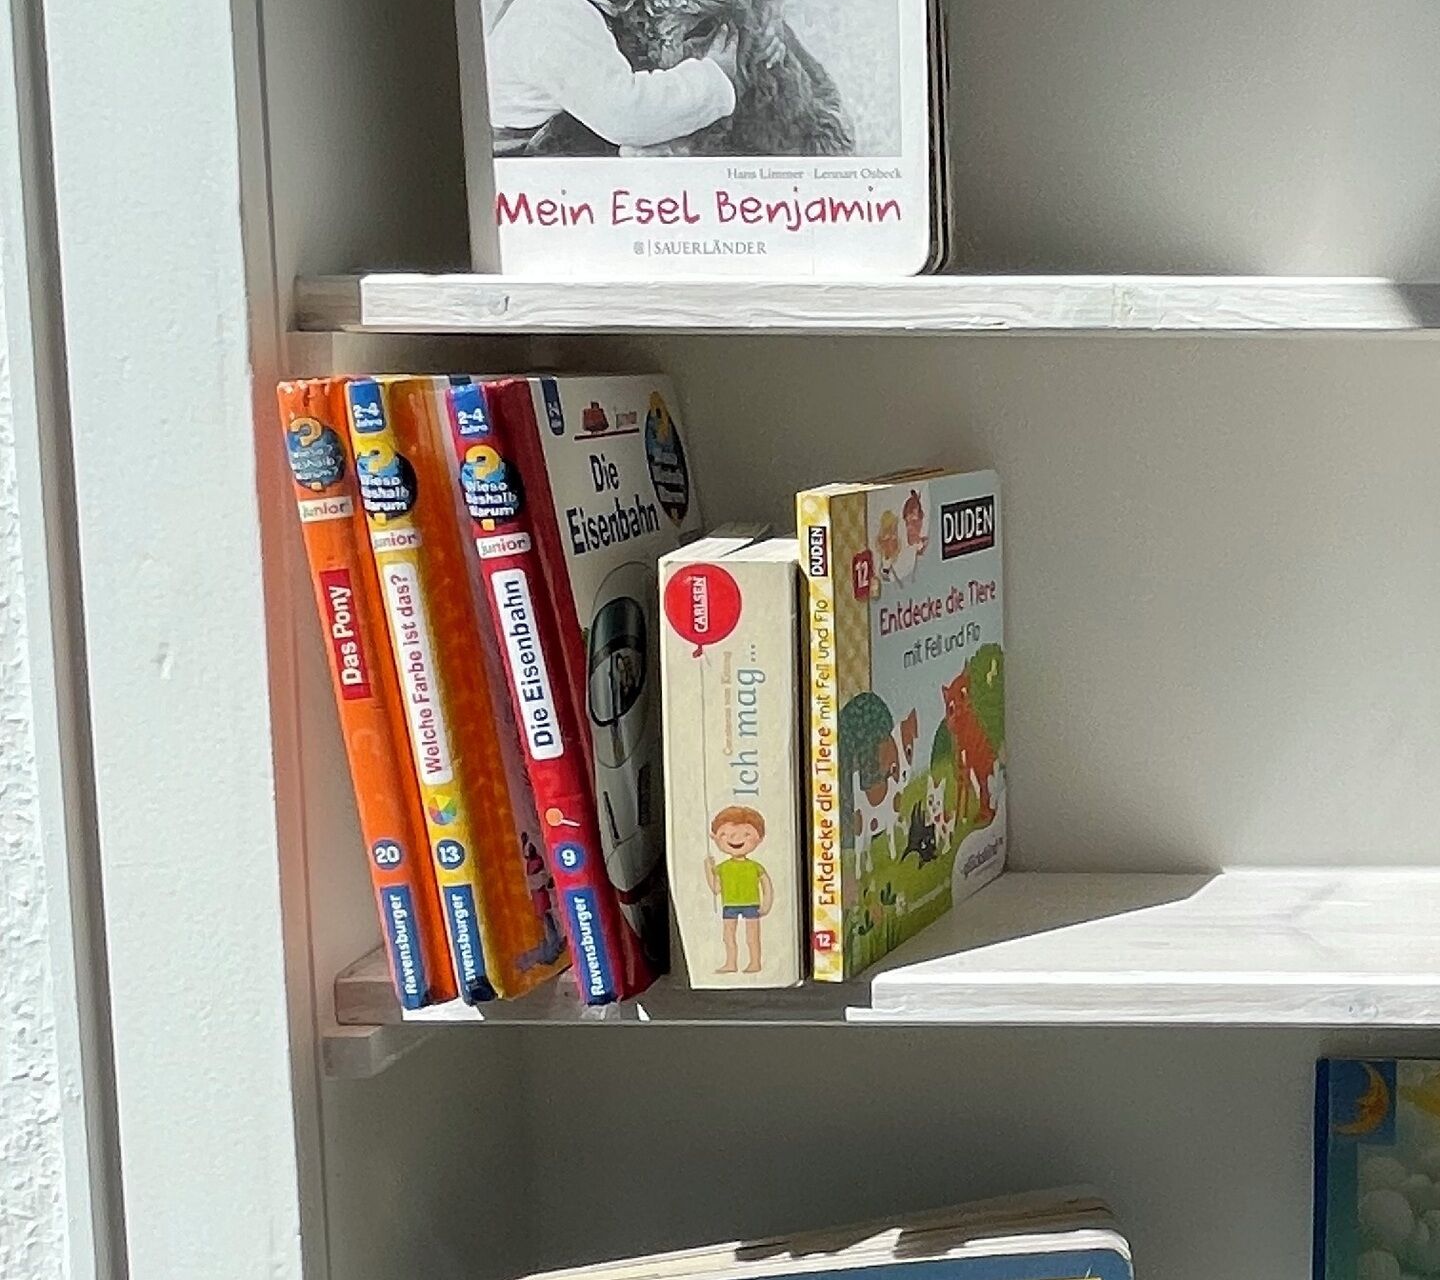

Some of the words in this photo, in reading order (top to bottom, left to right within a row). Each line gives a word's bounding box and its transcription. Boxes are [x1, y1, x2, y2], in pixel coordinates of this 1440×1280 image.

[495, 189, 594, 227] Mein
[611, 190, 700, 225] Esel
[716, 185, 901, 231] Benjamin
[654, 240, 767, 256] SAUERLÄNDER
[458, 408, 486, 425] 2-4
[588, 452, 619, 493] Die
[479, 536, 527, 555] junior
[566, 493, 661, 556] Eisenbahn
[943, 505, 993, 544] DUDEN
[810, 527, 825, 576] DUDEN
[328, 584, 352, 638] Pony
[391, 574, 414, 616] das?
[692, 576, 707, 632] CARLSEN
[814, 599, 829, 624] Flo
[879, 596, 943, 637] Entdecke
[340, 638, 363, 685] Das
[504, 579, 546, 703] Eisenbahn
[816, 628, 830, 658] und
[408, 650, 431, 705] Farbe
[816, 662, 830, 690] Fell
[737, 669, 766, 737] mag
[418, 708, 442, 775] Welche
[530, 706, 555, 749] Die
[729, 750, 759, 796] Ich
[375, 846, 400, 865] 20
[437, 846, 461, 864] 13
[562, 849, 575, 867] 9
[816, 815, 835, 905] Entdecke
[389, 894, 417, 994] Ravensburger
[451, 894, 478, 993] vensburger
[573, 896, 606, 996] Ravensburger
